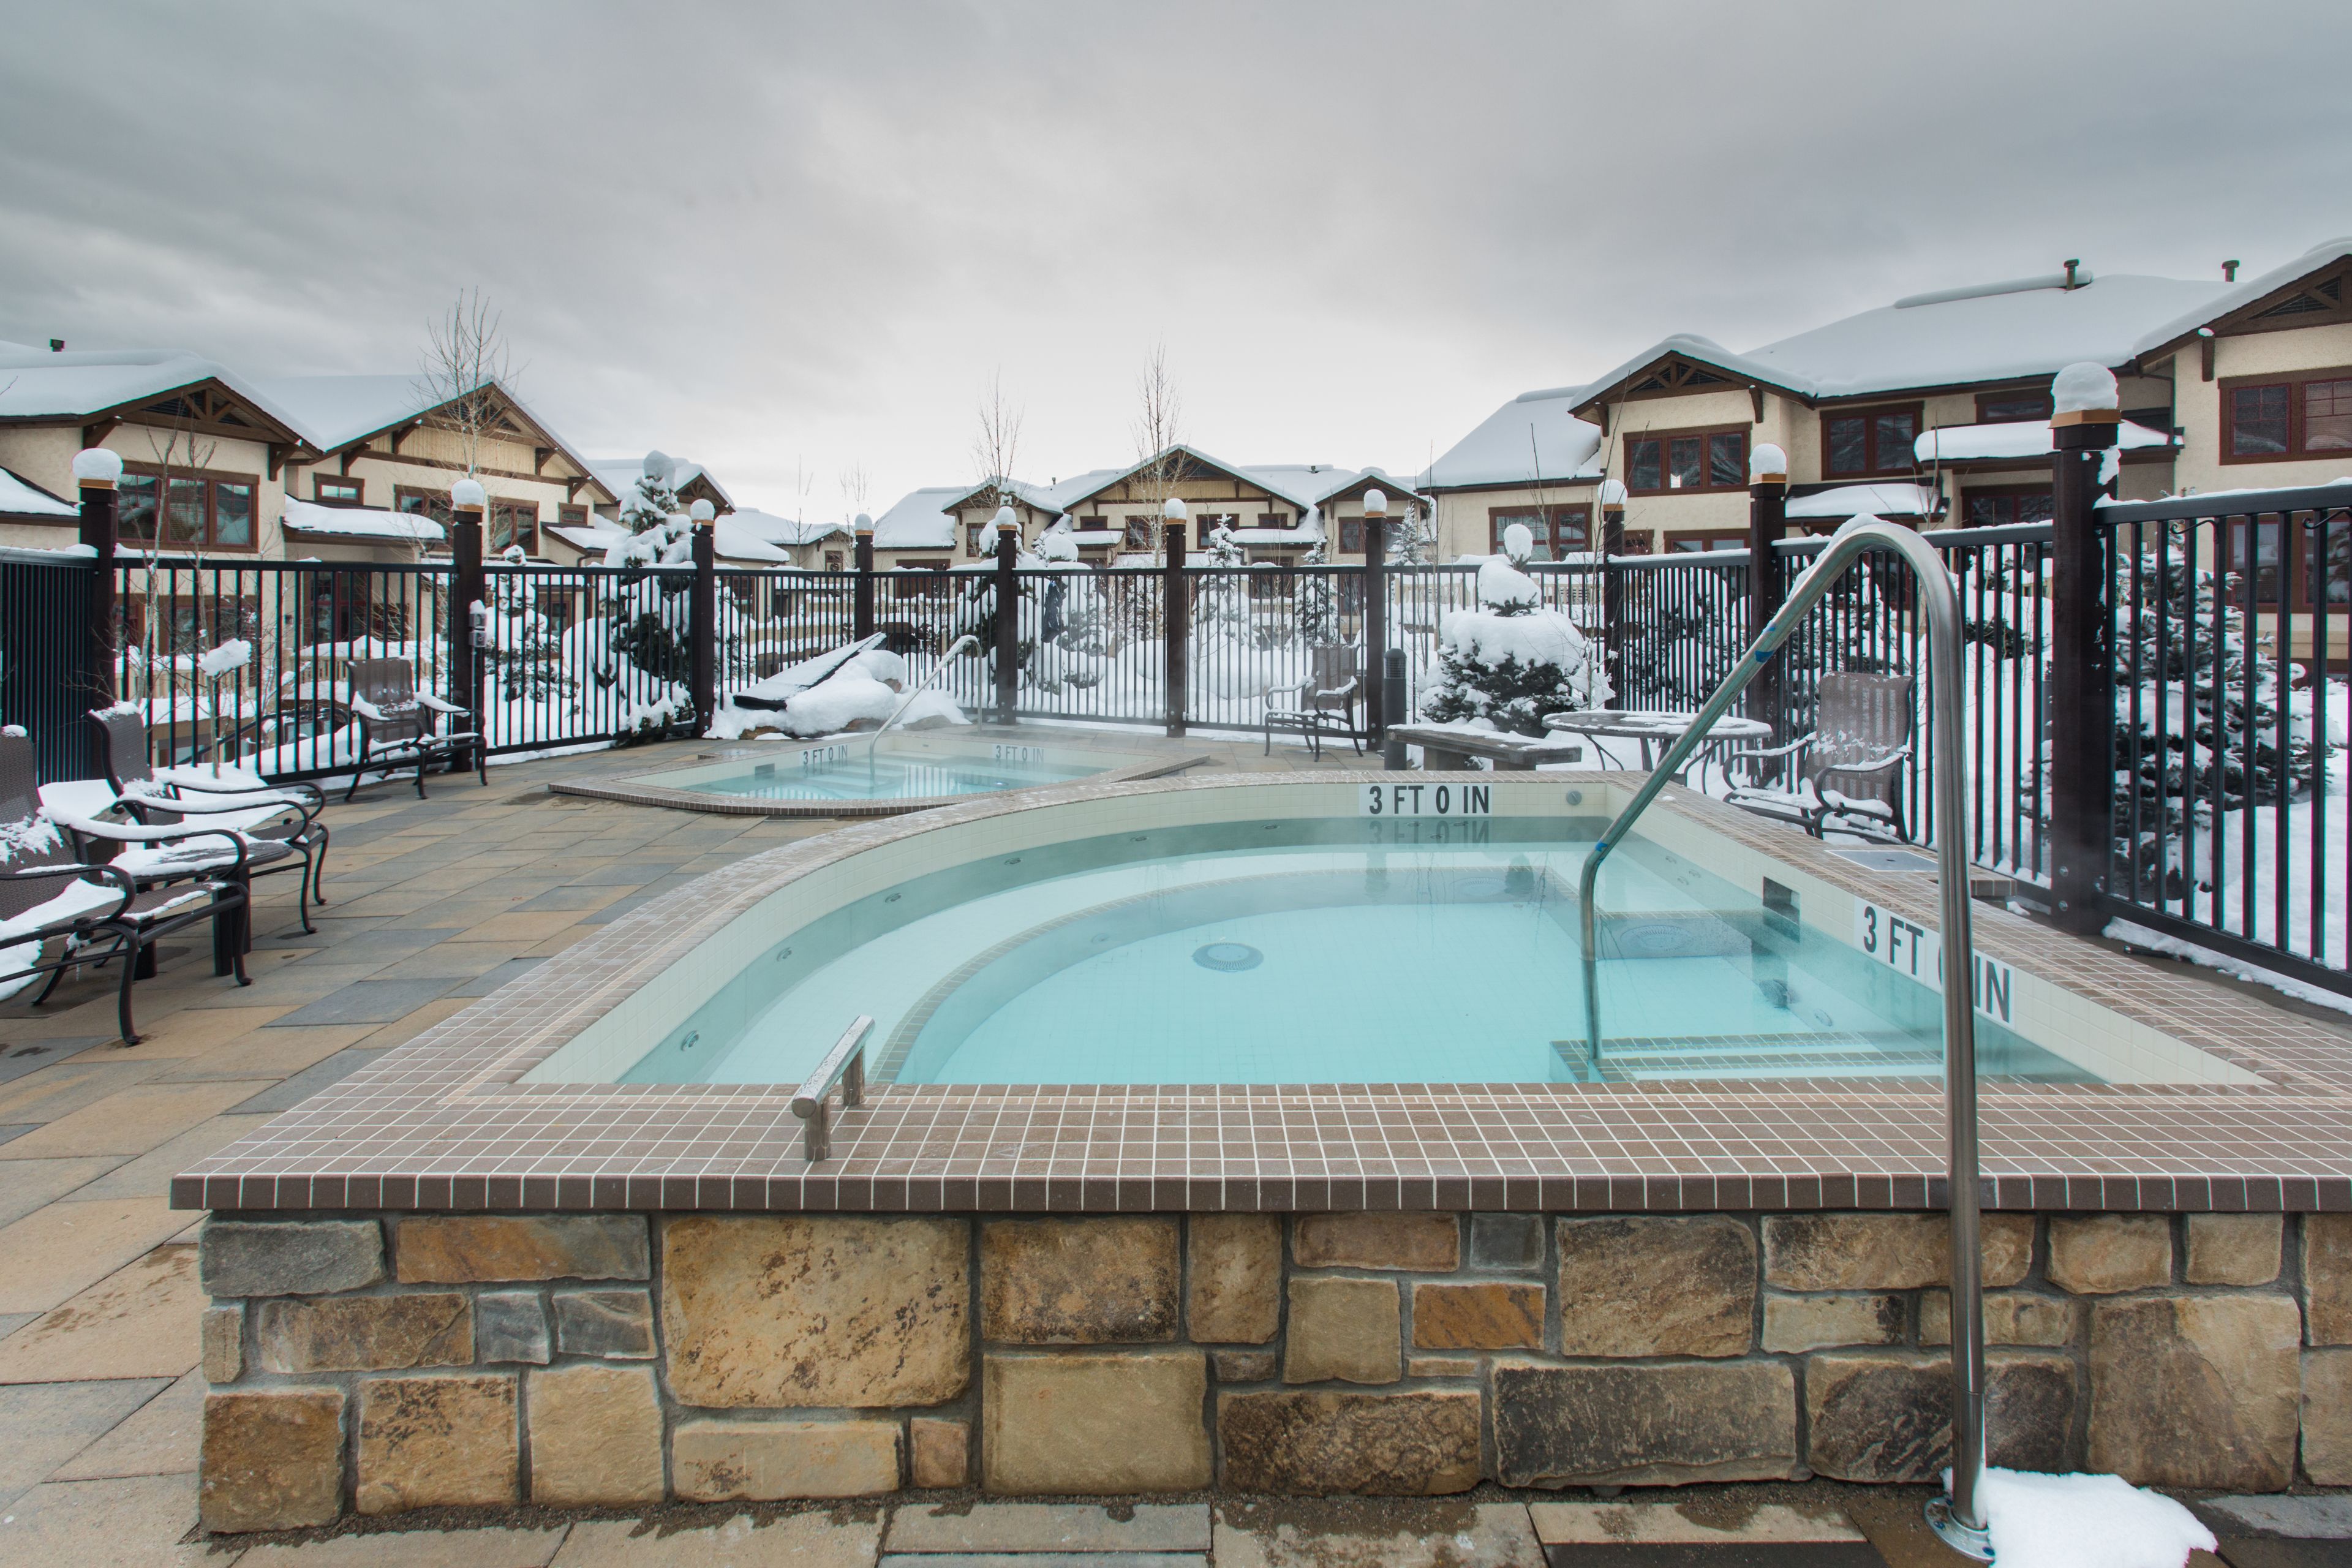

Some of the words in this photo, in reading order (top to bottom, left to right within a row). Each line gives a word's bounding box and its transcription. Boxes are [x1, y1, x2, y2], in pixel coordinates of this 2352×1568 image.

[803, 751, 809, 766] 3
[813, 748, 824, 764] FT
[838, 745, 848, 759] IN
[996, 745, 1001, 759] 3
[1006, 746, 1017, 760] FT
[1033, 748, 1044, 763] IN
[1369, 786, 1382, 814] 3
[1394, 785, 1424, 814] FT
[1463, 786, 1489, 813] IN
[1863, 906, 1877, 953] 3
[1889, 916, 1924, 976] FT
[1974, 955, 2010, 1023] IN
